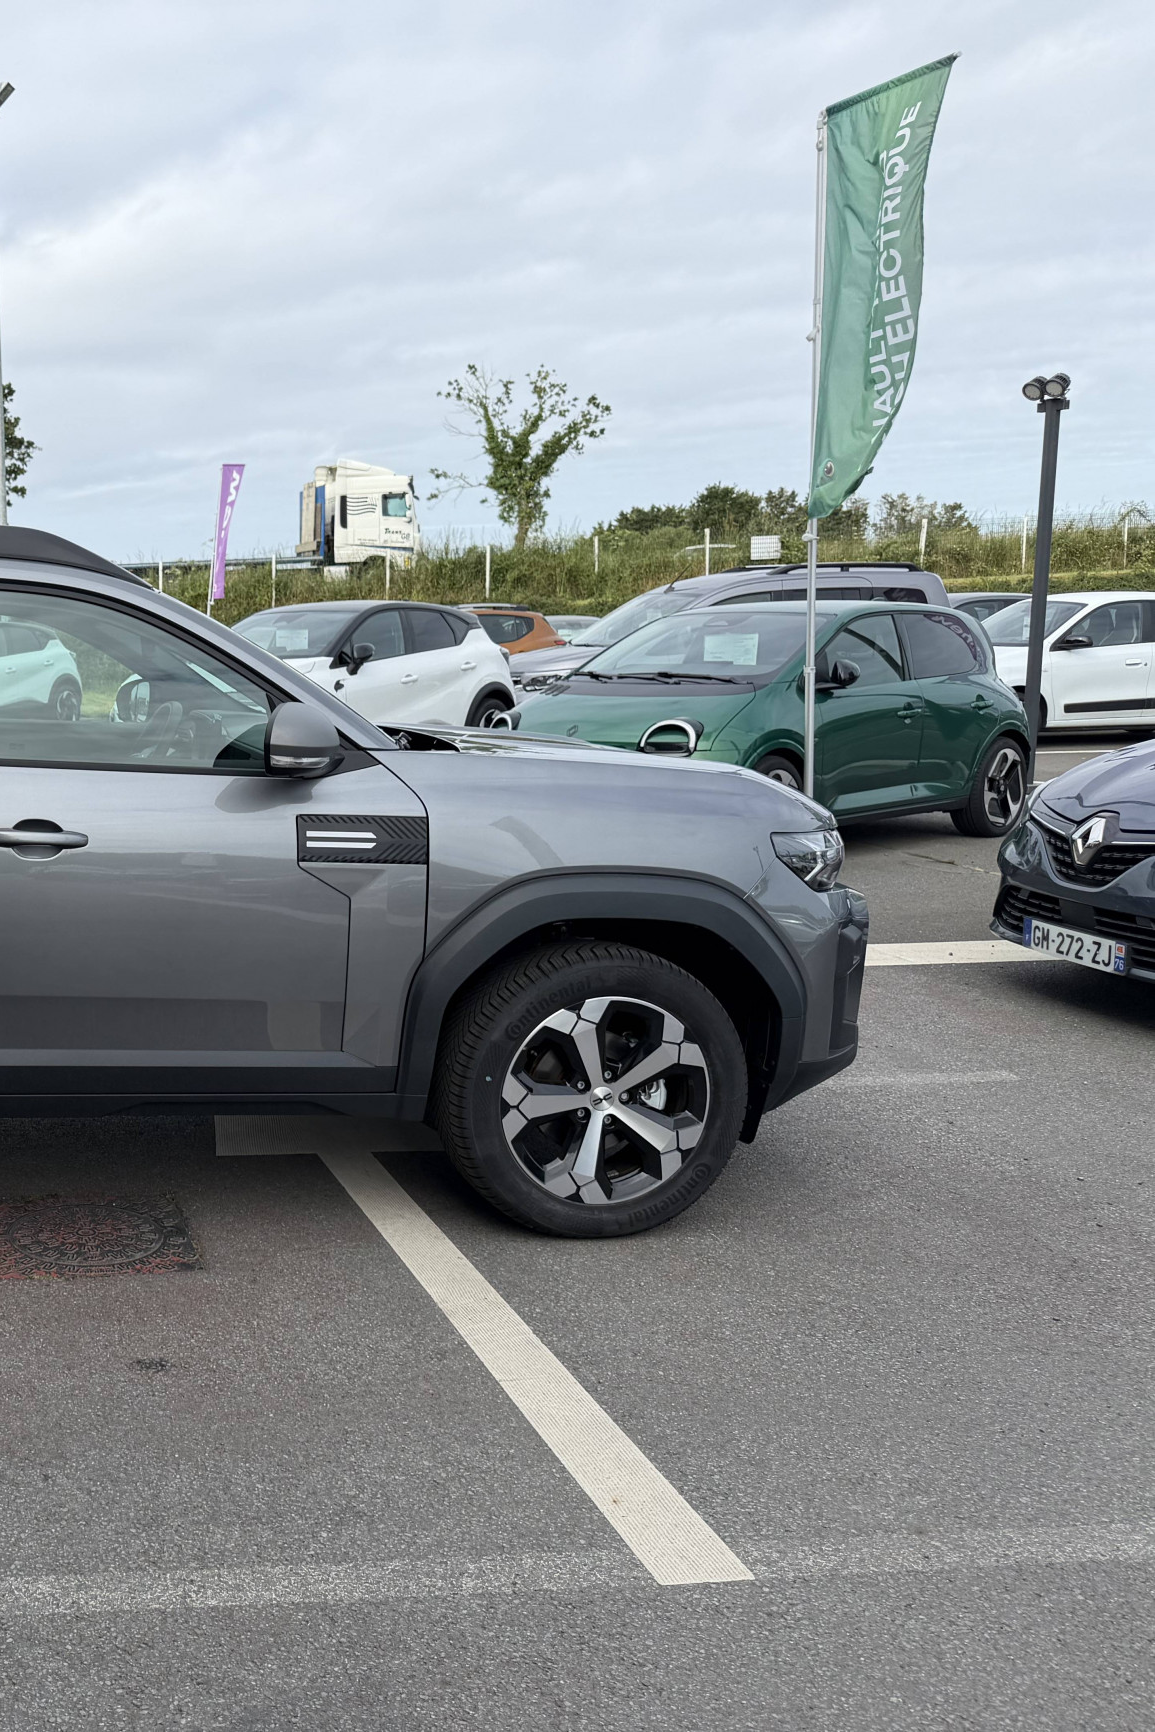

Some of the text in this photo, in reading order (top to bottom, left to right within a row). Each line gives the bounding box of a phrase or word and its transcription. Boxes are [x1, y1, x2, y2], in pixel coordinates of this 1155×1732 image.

[879, 101, 922, 346] ELECTRIQUE
[1033, 925, 1112, 967] GM-272-ZJ
[1115, 959, 1124, 970] 76
[505, 976, 592, 1041] Continental
[628, 1162, 712, 1227] Continental
